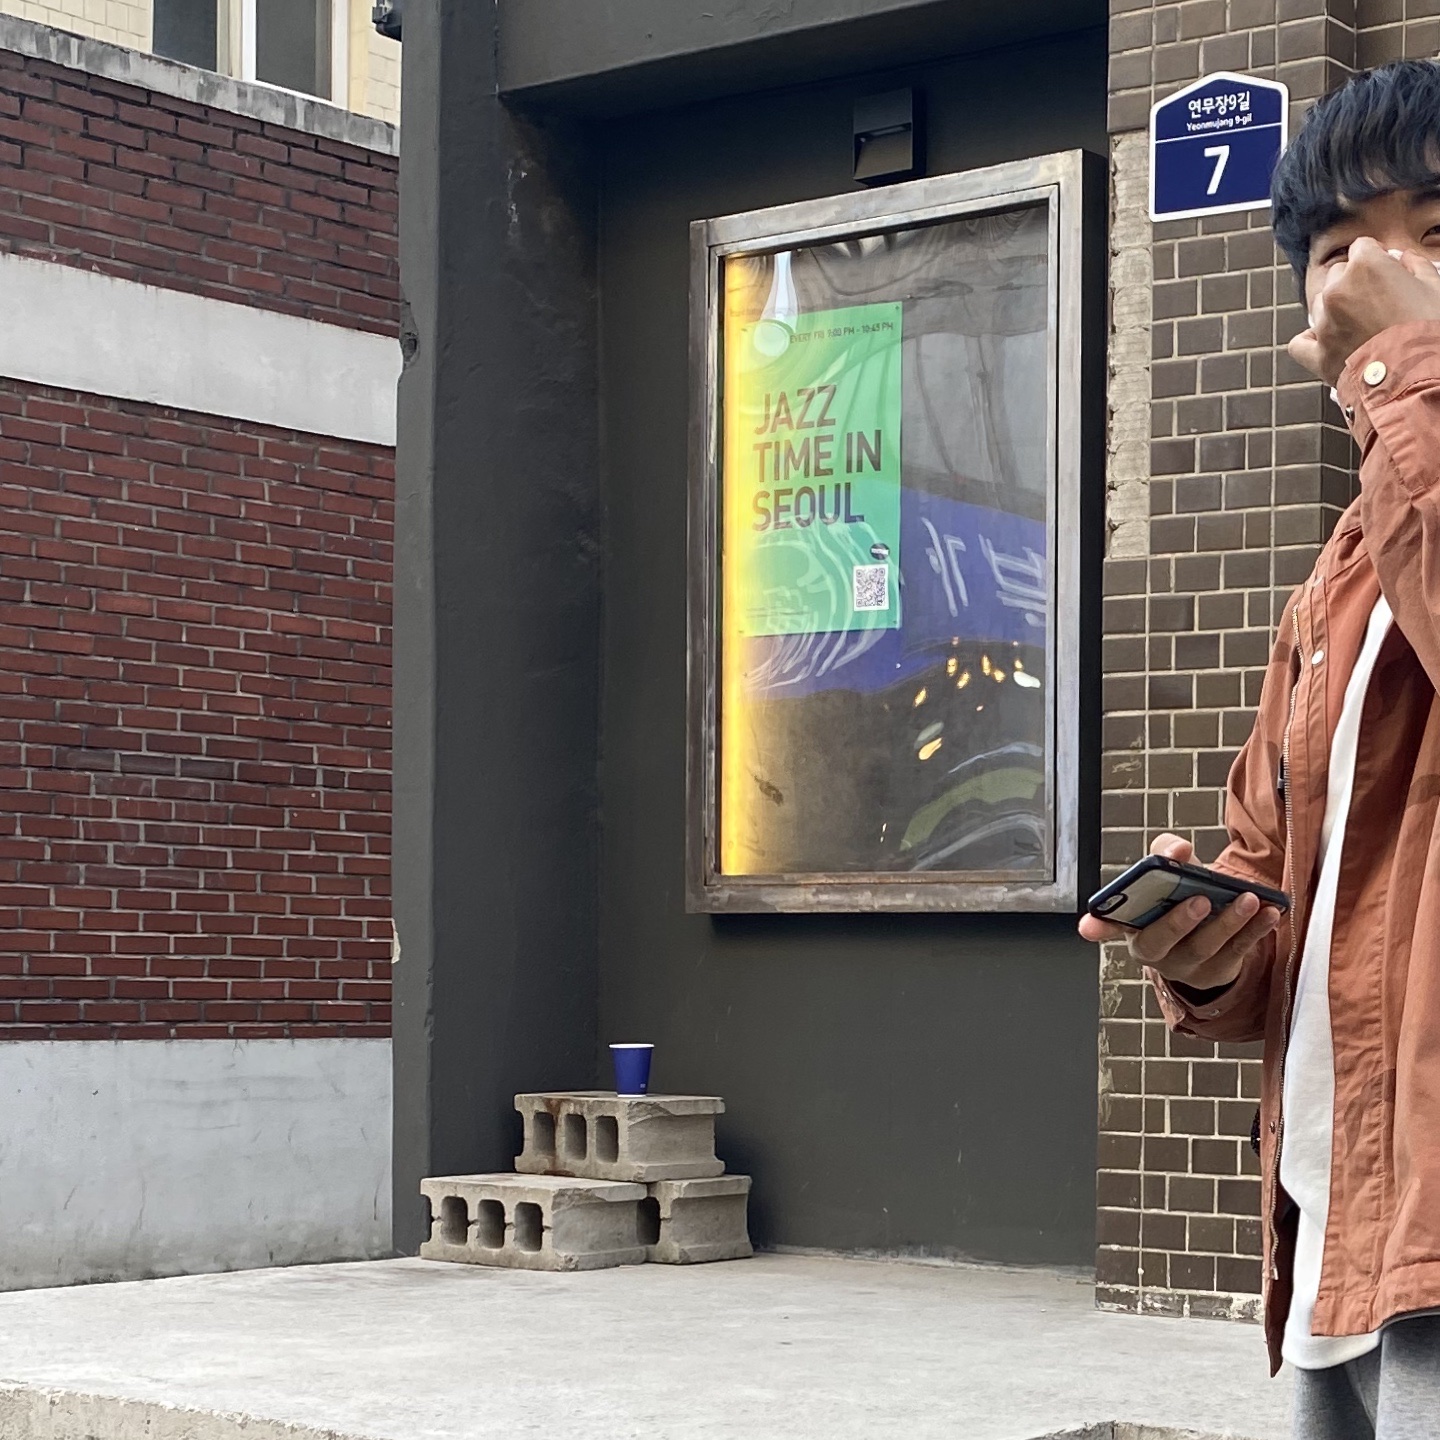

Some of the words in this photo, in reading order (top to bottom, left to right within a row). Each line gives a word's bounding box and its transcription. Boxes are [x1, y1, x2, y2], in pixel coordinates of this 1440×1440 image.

[1186, 118, 1233, 132] Yeonmujang
[1235, 113, 1252, 125] 9-gil
[1188, 91, 1250, 119] 연무장9길
[1204, 145, 1230, 195] 7
[755, 383, 837, 436] JAZZ
[753, 434, 834, 482] TIME
[845, 429, 882, 474] IN
[752, 482, 865, 532] SEOUL
